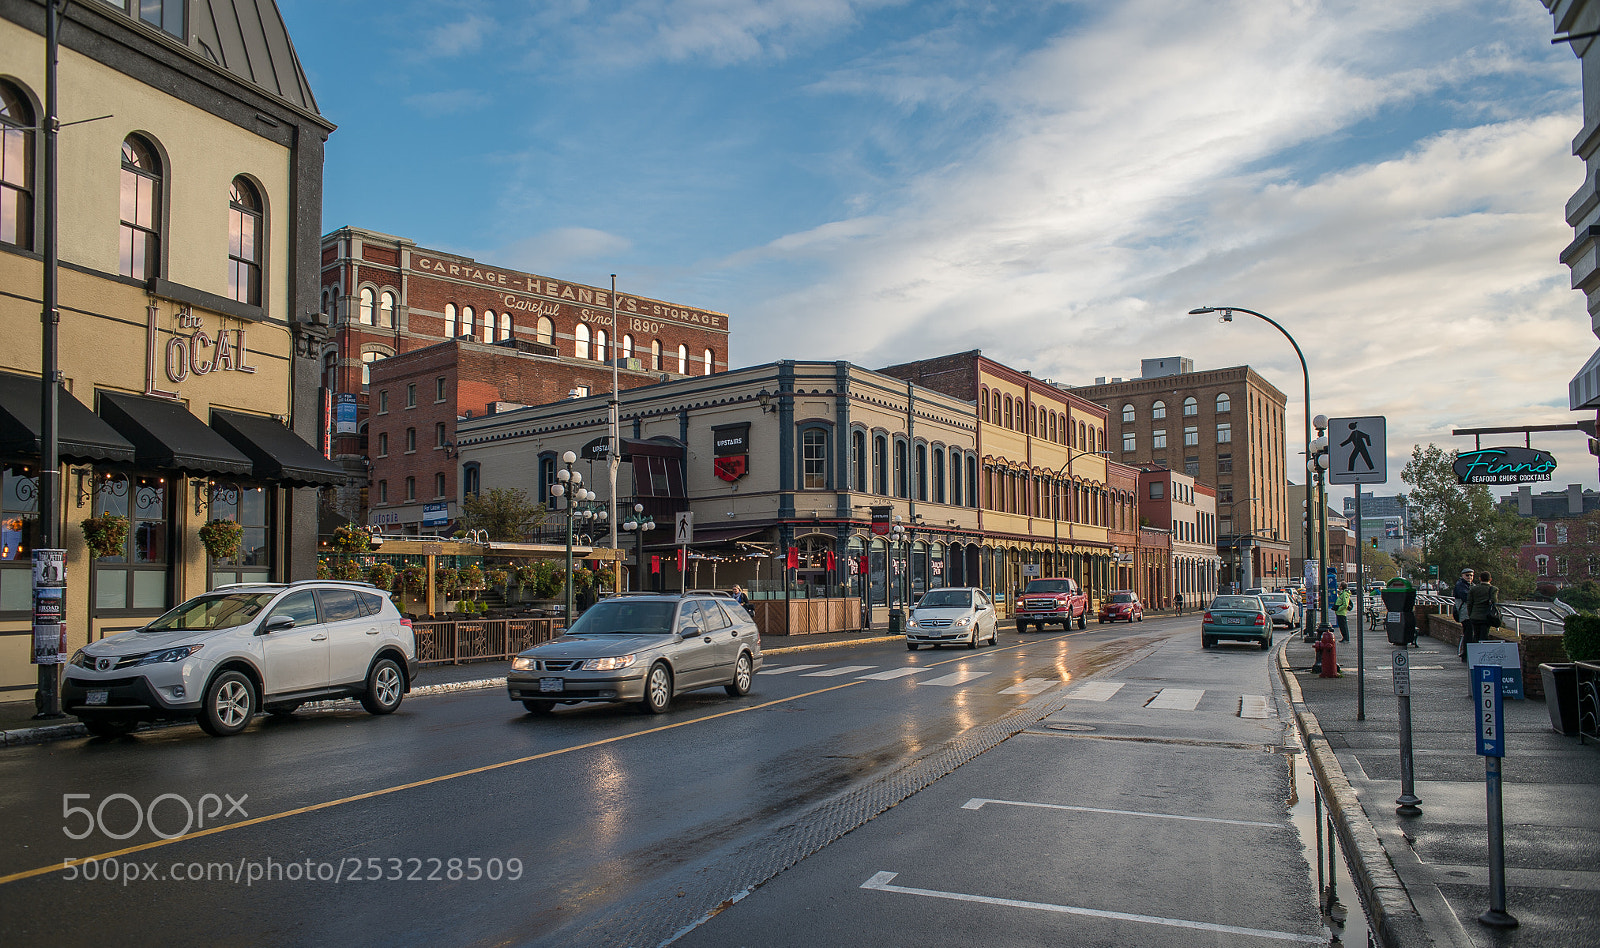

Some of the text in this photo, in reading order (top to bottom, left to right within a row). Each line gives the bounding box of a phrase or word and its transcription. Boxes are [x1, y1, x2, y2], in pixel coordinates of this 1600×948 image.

[418, 259, 720, 327] CARTAGE HEANEY'S STORAGE
[176, 305, 205, 329] the
[580, 308, 614, 326] Sinc
[145, 305, 259, 400] LOCAL
[717, 438, 743, 446] UPSTAIRS
[1457, 449, 1556, 482] Finn's
[1471, 473, 1550, 483] SEAFOOD CHOPS COCKTAILS
[1483, 669, 1491, 680] P
